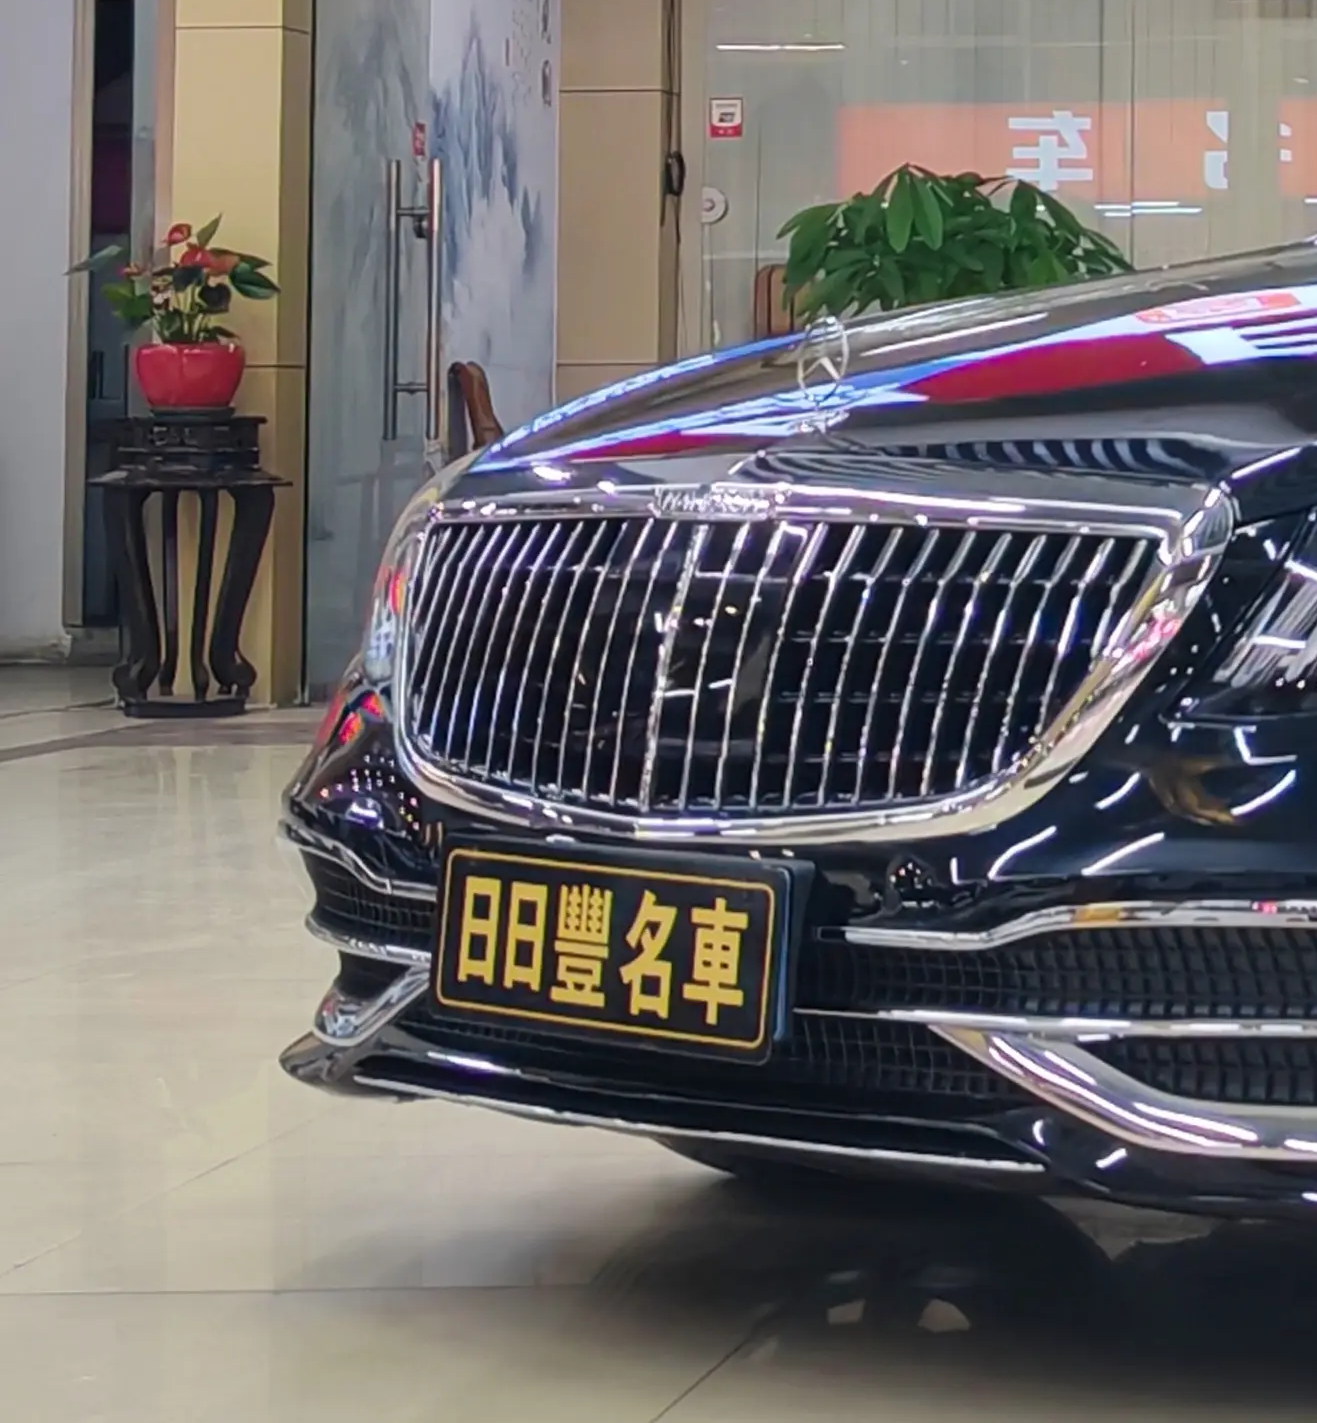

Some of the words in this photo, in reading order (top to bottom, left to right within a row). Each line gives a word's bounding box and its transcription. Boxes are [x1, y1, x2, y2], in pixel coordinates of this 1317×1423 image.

[457, 877, 750, 1026] 日日豐名車
